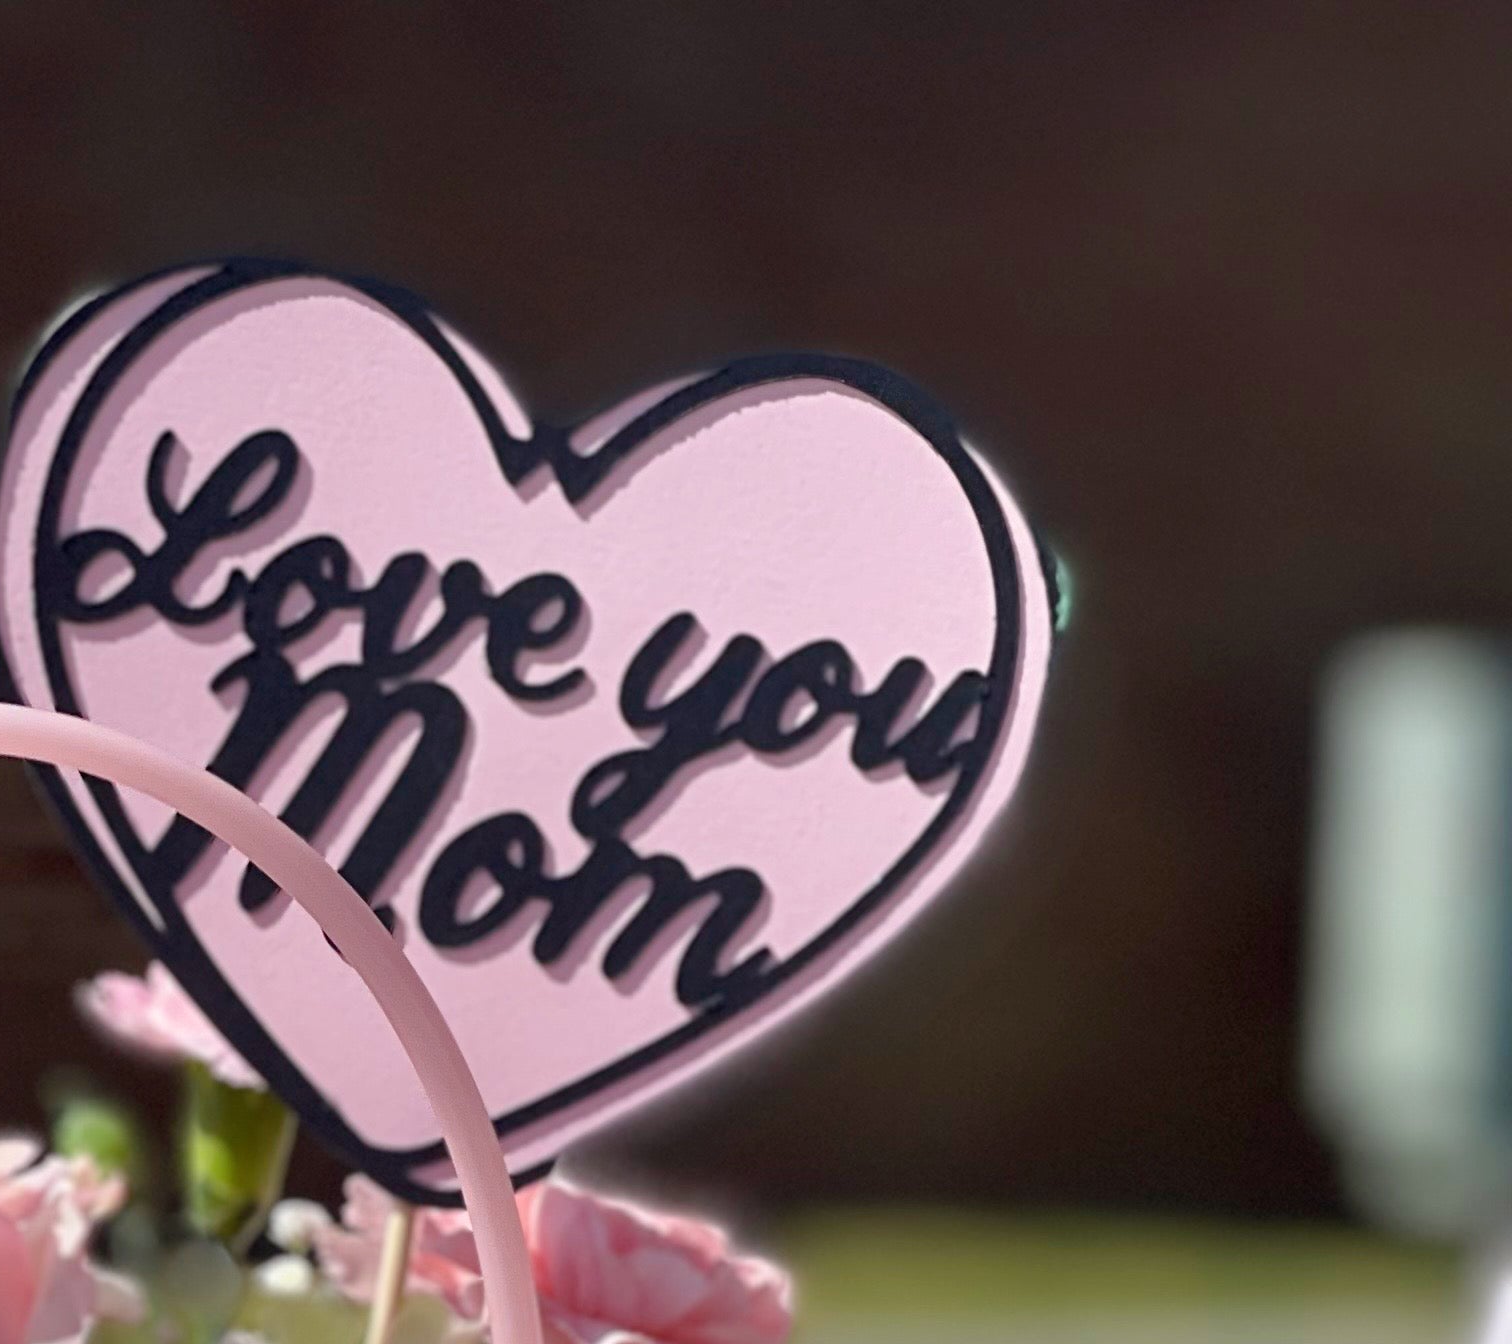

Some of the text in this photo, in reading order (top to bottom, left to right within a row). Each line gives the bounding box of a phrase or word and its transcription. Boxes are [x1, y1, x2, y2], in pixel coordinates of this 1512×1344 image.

[57, 428, 994, 844] Love you
[152, 650, 776, 1010] Mom
